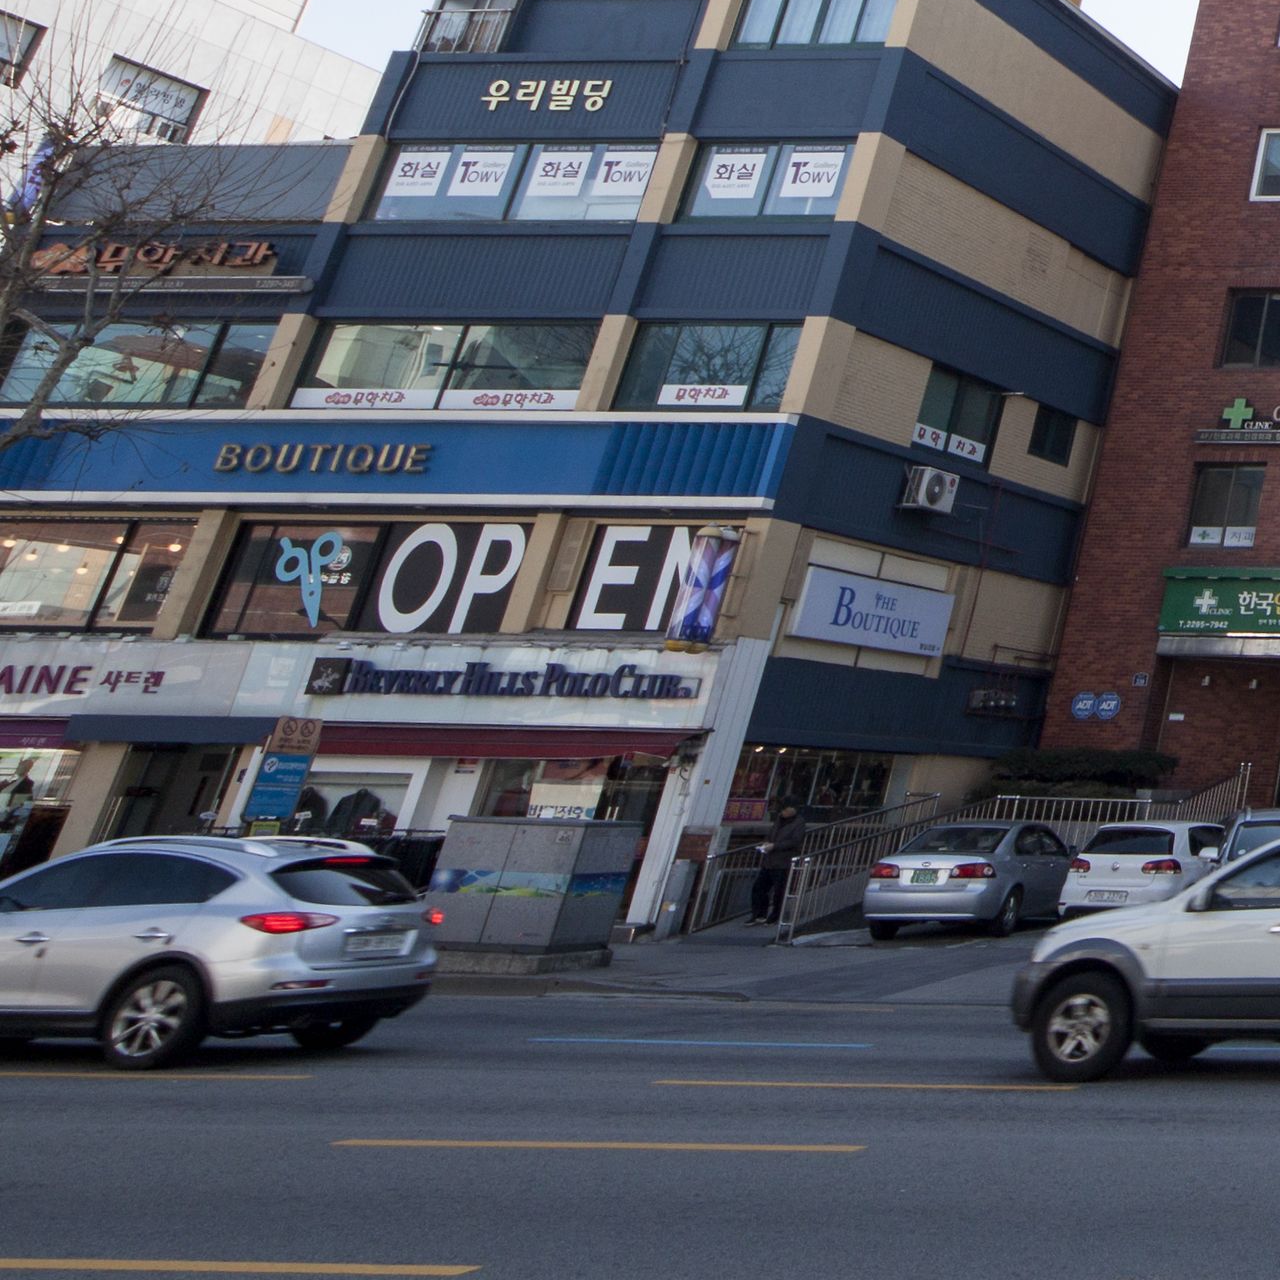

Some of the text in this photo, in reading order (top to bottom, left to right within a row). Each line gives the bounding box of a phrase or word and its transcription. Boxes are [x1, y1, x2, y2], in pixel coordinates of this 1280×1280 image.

[480, 77, 613, 113] 우리빌딩
[398, 161, 441, 179] 화실
[539, 161, 583, 179] 화실
[714, 163, 756, 181] 화실
[1244, 421, 1274, 431] CLINIC
[212, 443, 433, 474] BOUTIQUE
[875, 591, 898, 611] THE
[830, 586, 920, 639] BOUTIQUE
[1209, 608, 1232, 616] CLINIC
[100, 670, 165, 693] 샤트렌
[347, 660, 682, 699] BEVERLY HILLS POLO CLUB
[1075, 700, 1093, 710] ADT
[1099, 700, 1117, 710] ADT
